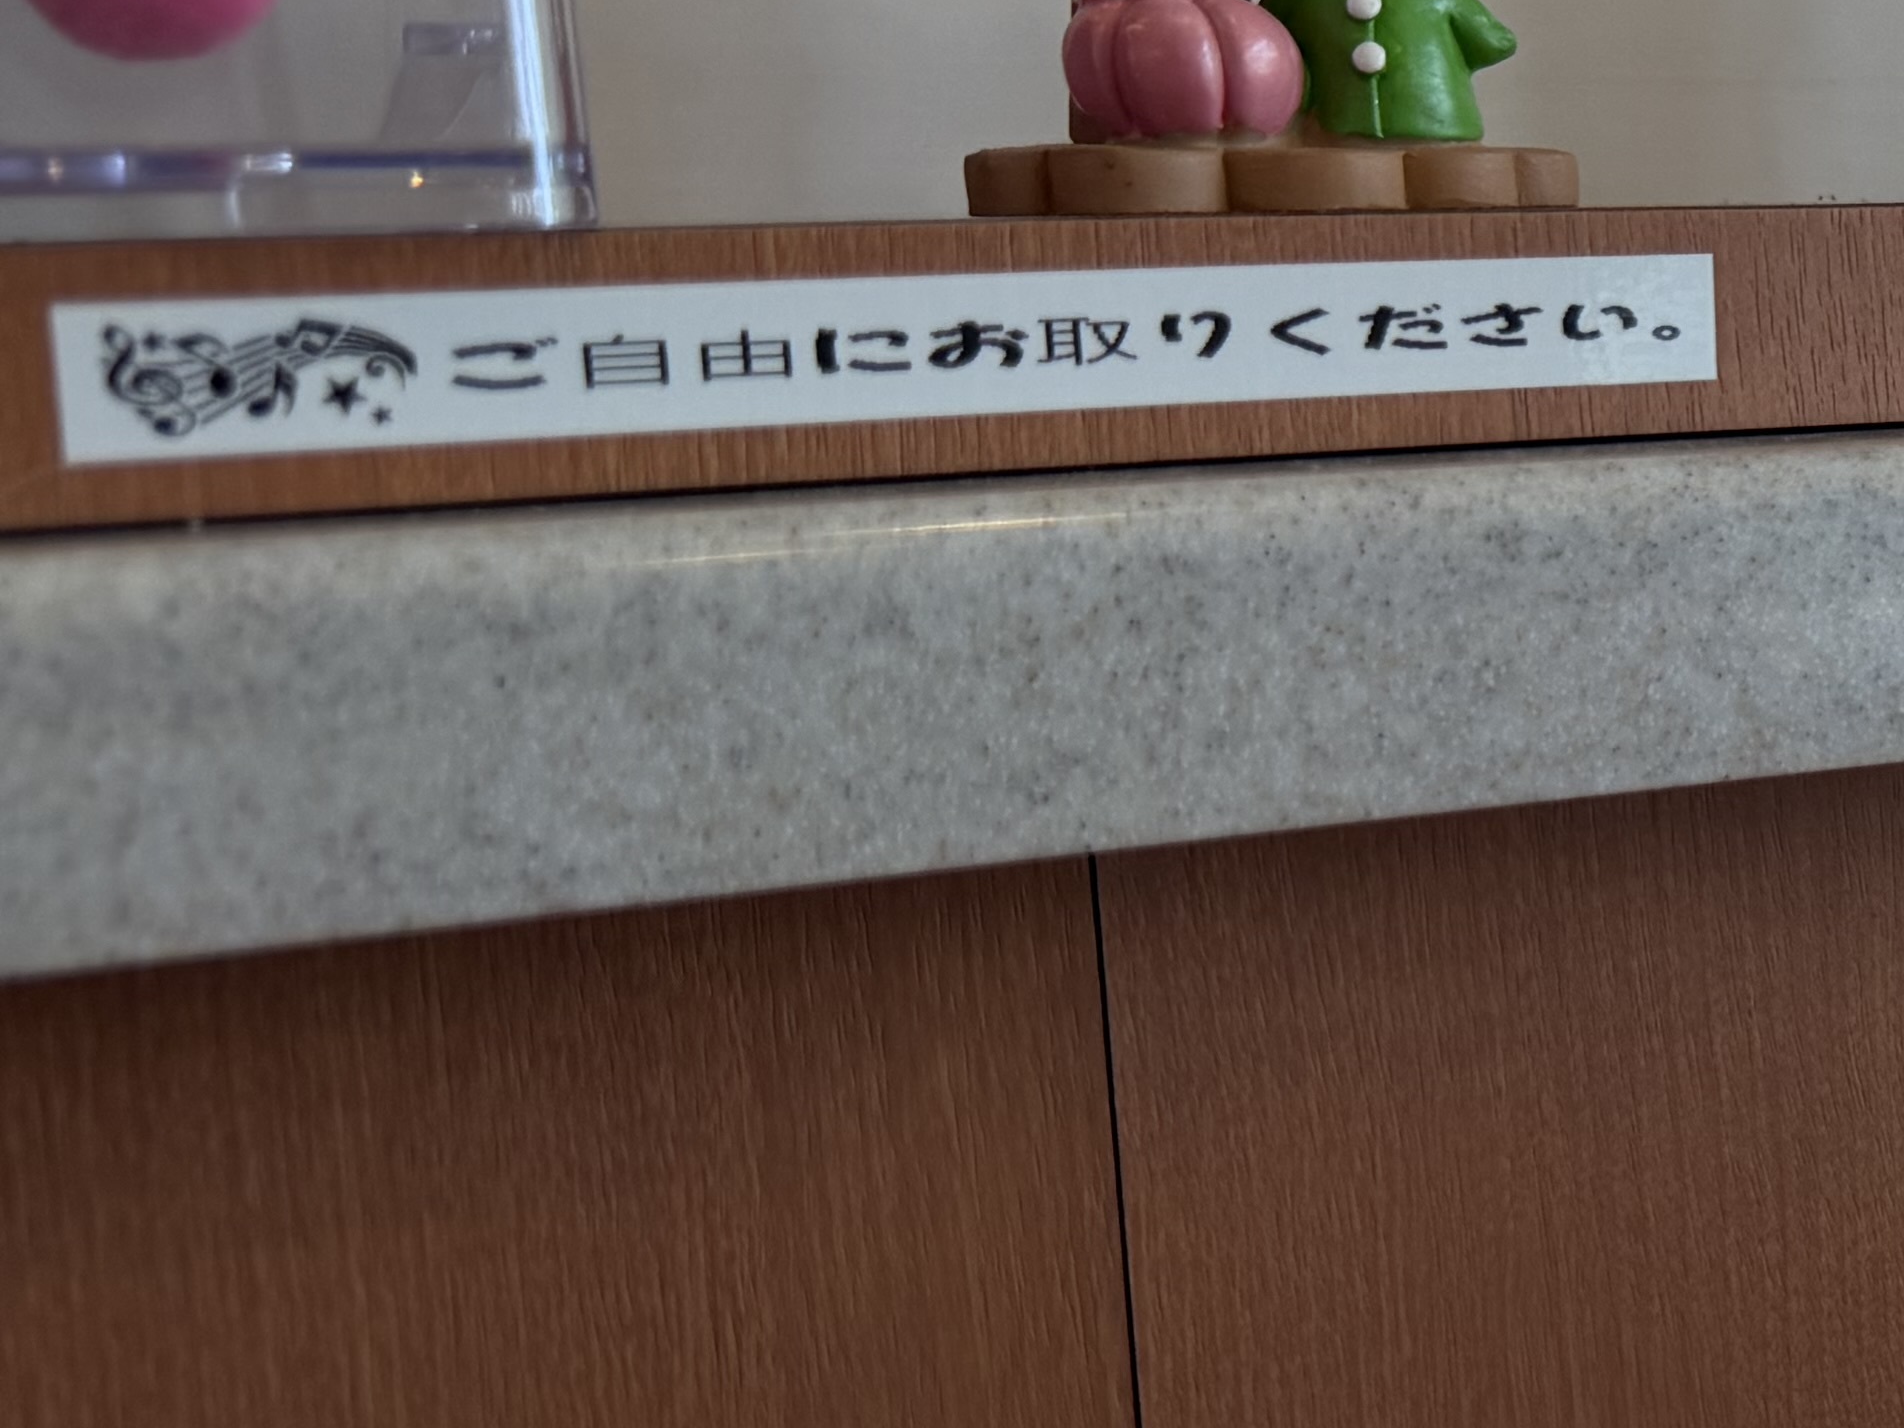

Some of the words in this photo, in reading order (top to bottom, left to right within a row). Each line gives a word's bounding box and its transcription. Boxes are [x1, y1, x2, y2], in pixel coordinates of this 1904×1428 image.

[452, 301, 1682, 391] ご自由にお取りください。
